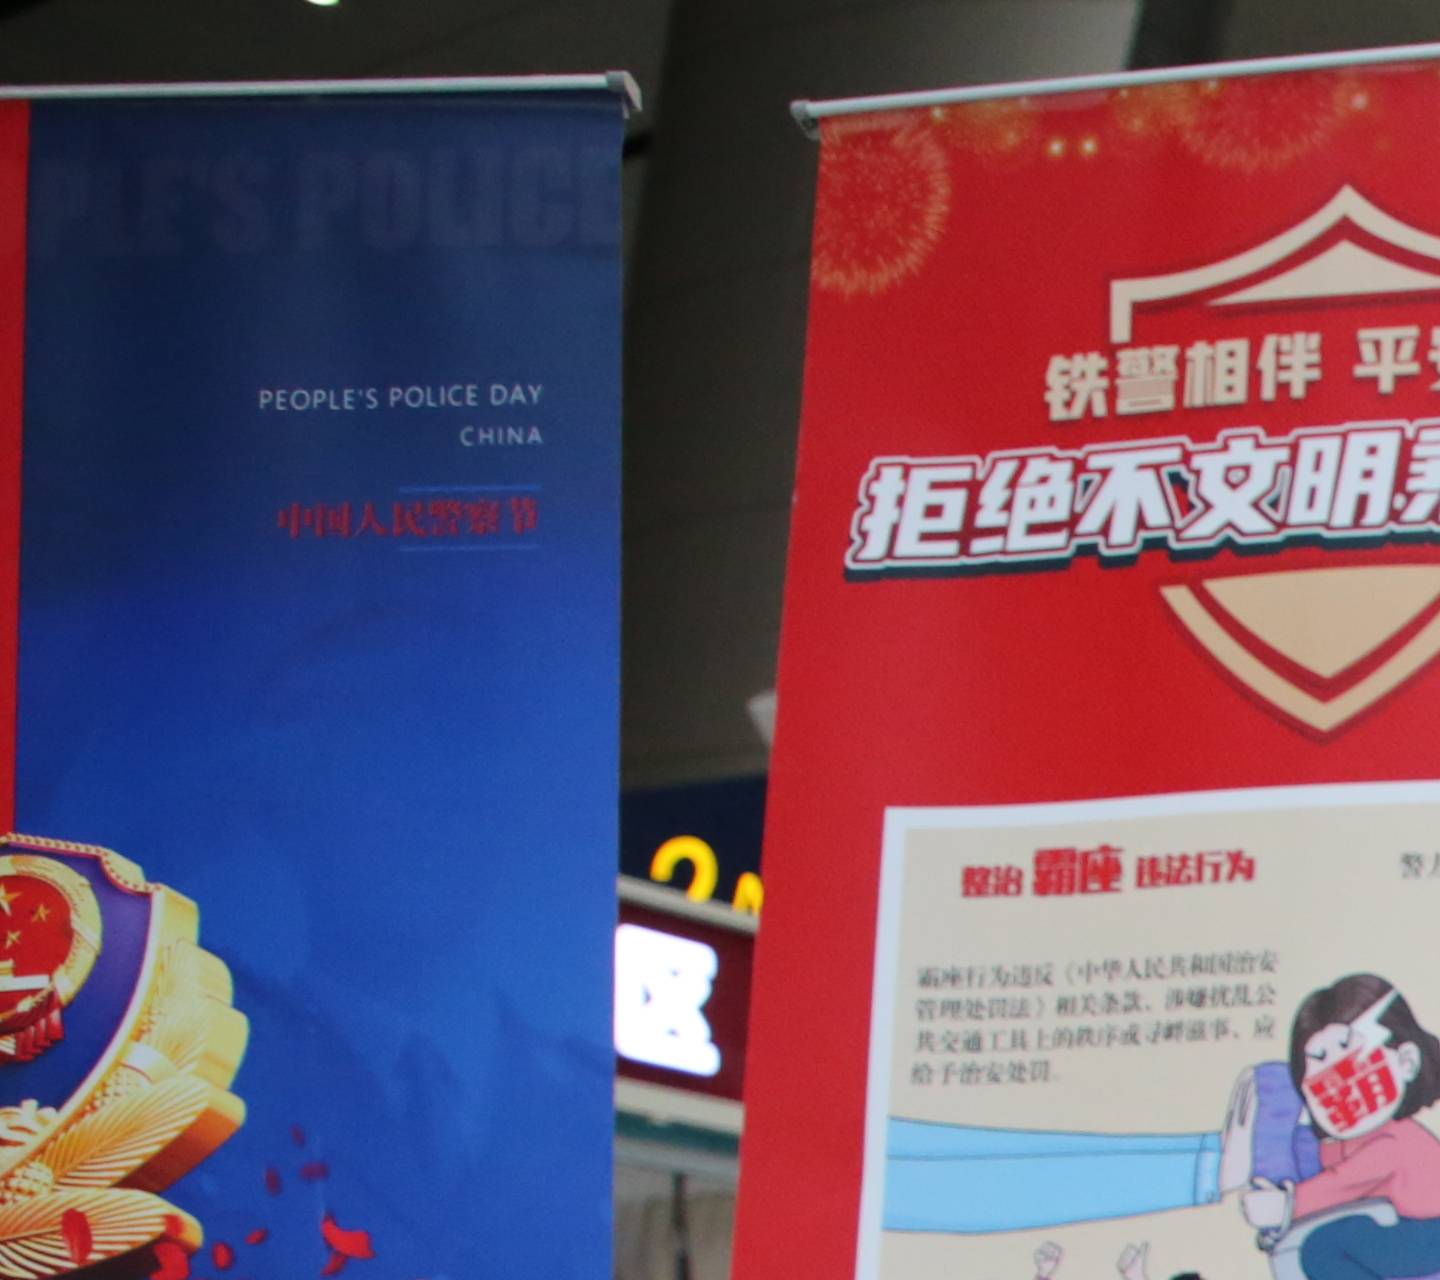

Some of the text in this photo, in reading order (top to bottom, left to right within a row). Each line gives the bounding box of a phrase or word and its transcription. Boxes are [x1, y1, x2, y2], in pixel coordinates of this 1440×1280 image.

[259, 383, 543, 411] PEOPLE'S POLICE DAY
[1043, 329, 1322, 422] 铁警相伴
[459, 426, 544, 447] CHINA
[277, 494, 538, 539] 中国人民警察节
[962, 844, 1256, 897] 整治 霸座 违法行为
[1304, 1045, 1398, 1132] 霸
